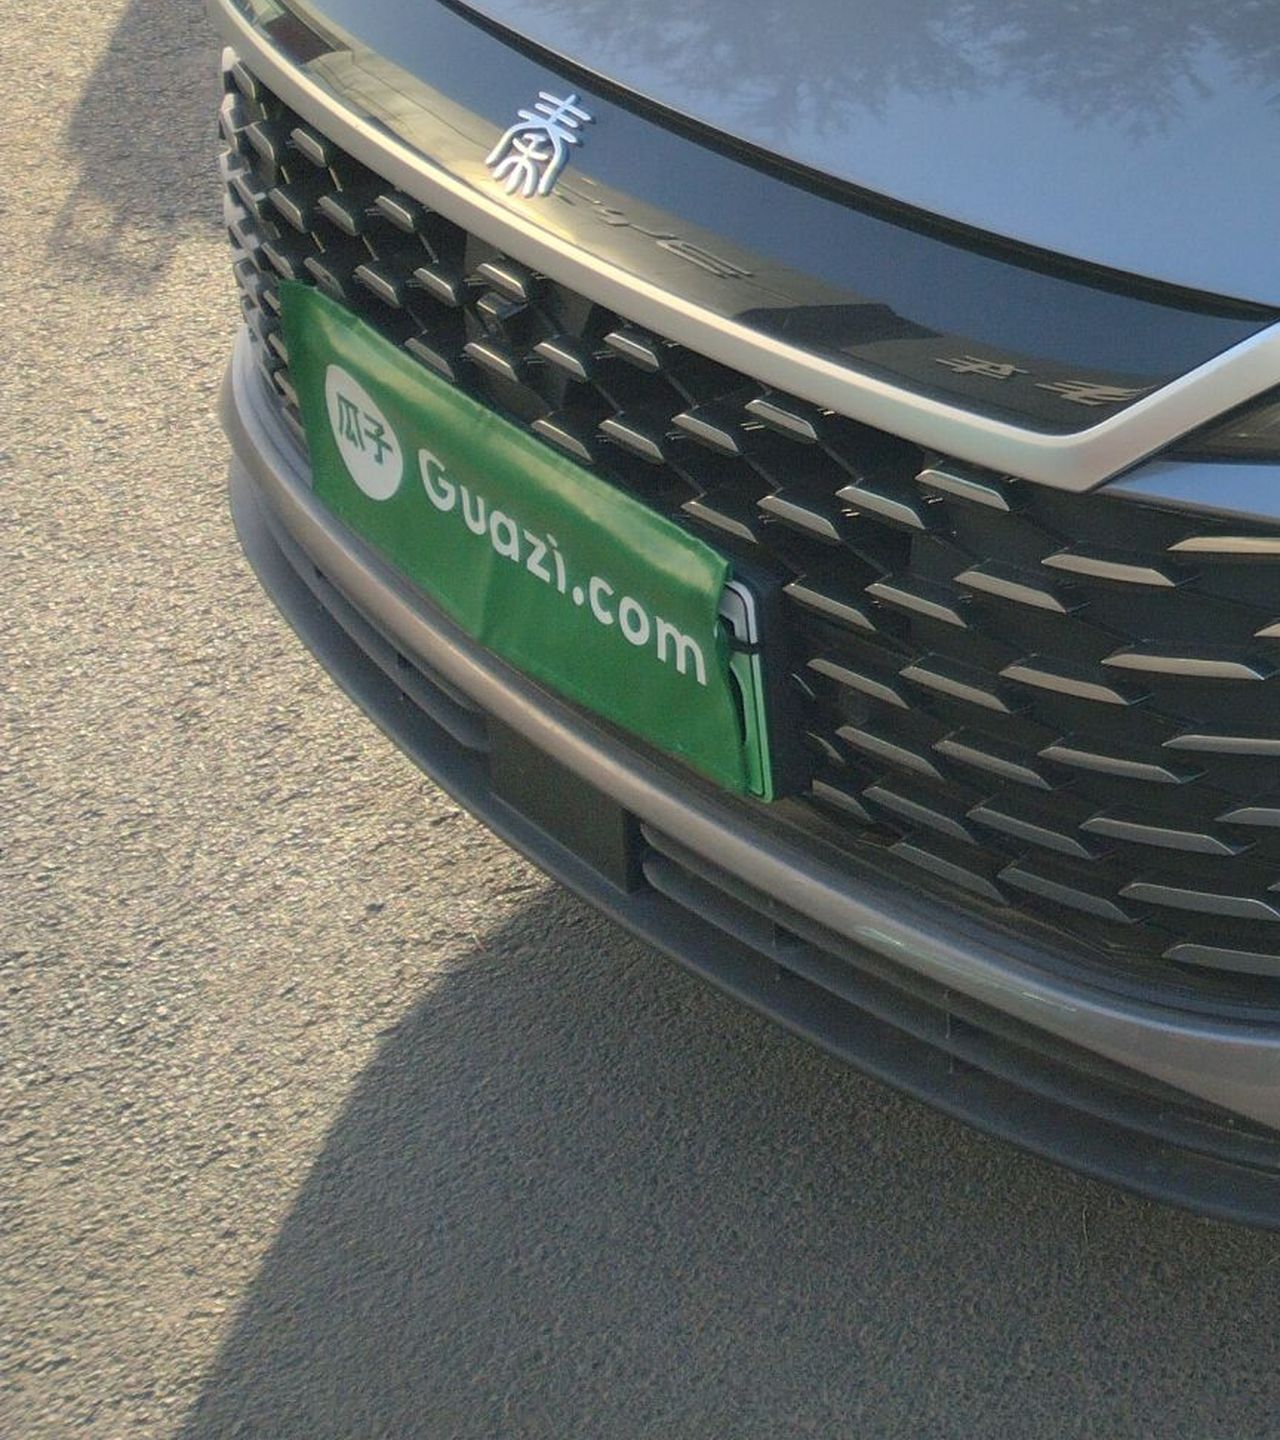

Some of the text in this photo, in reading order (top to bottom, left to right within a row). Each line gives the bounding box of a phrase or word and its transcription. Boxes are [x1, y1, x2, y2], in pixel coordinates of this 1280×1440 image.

[486, 91, 592, 198] 秦
[336, 391, 707, 686] 瓜子 Guazi.com
